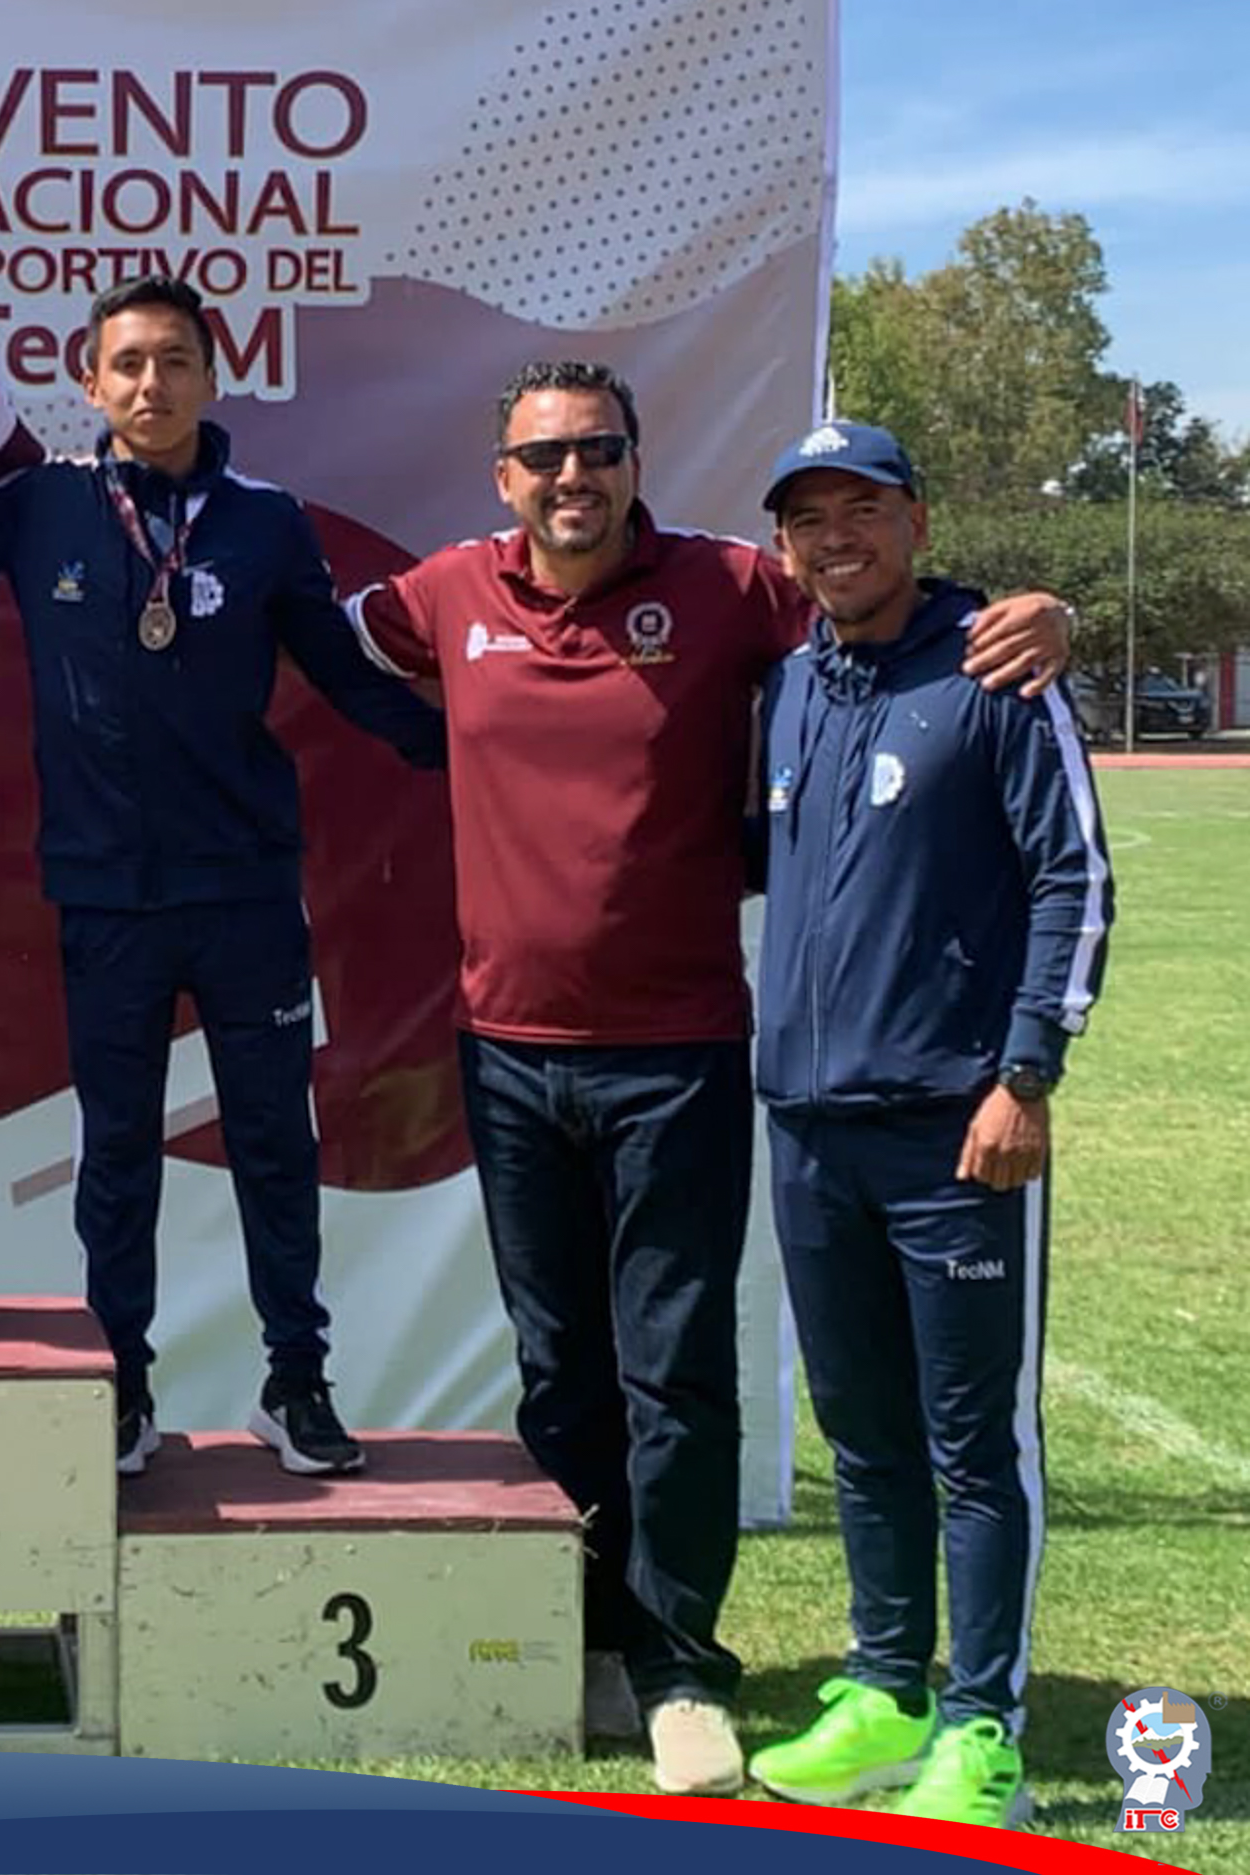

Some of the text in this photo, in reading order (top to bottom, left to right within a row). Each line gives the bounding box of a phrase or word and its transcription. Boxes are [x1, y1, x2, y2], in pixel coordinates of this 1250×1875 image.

[267, 249, 358, 292] DEL
[946, 1259, 1006, 1279] TecNM
[321, 1592, 378, 1709] 3
